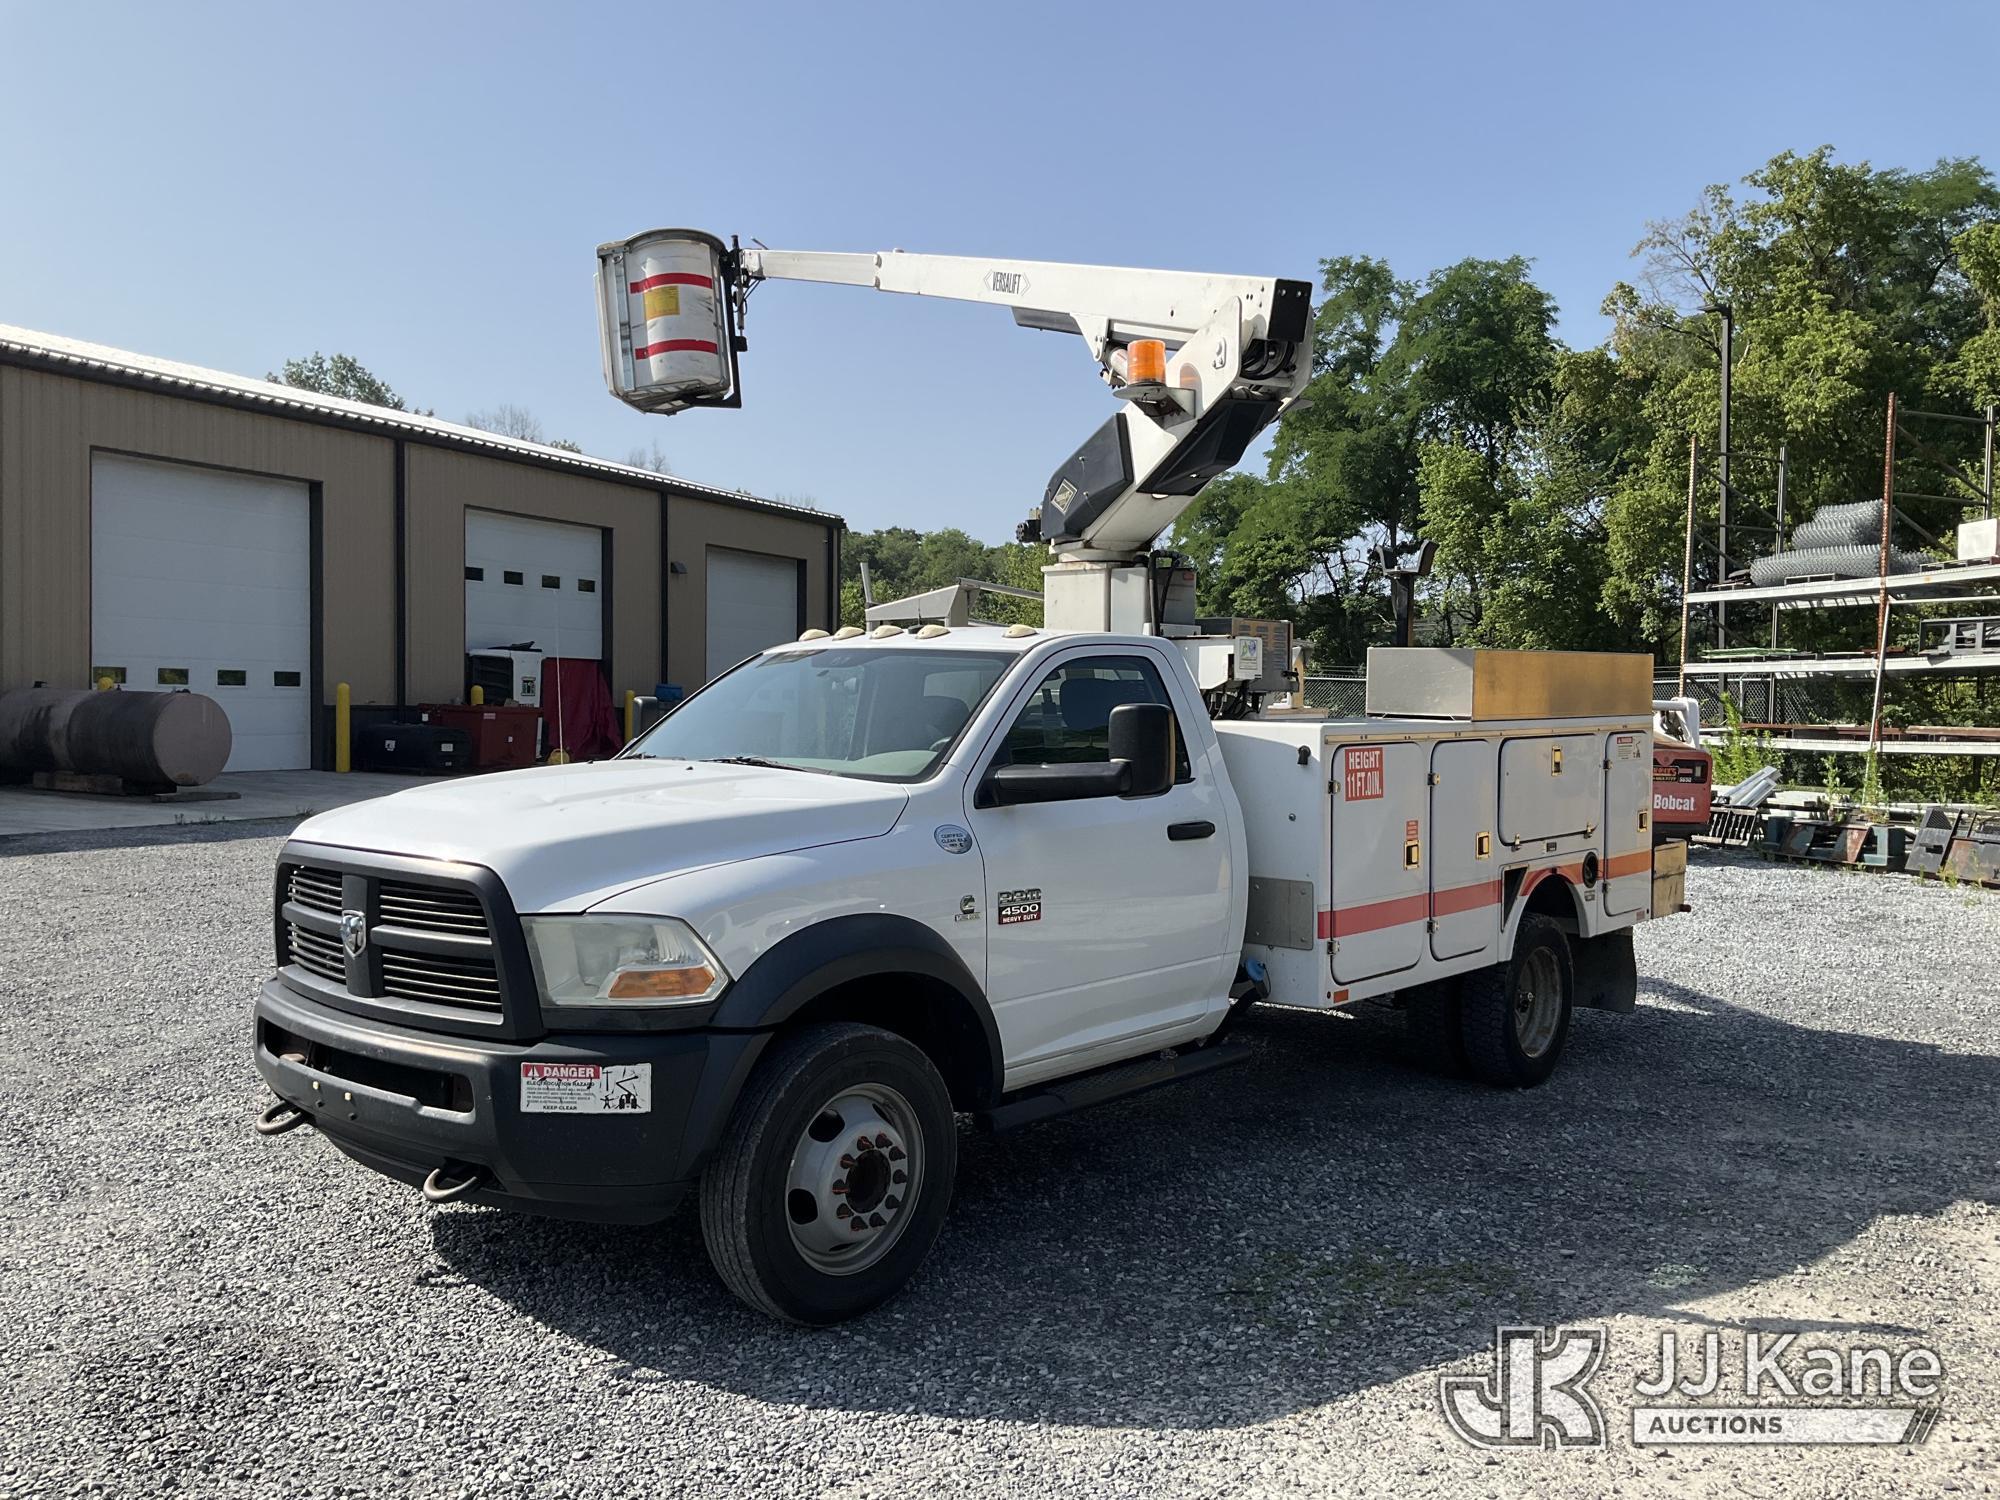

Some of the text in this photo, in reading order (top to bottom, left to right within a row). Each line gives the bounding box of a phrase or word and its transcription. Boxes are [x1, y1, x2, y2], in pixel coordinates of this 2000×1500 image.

[992, 271, 1021, 295] VERSALIFT
[1349, 751, 1380, 769] HEIGHT
[1653, 794, 1695, 811] Bobcat
[1002, 904, 1039, 915] 4500
[1002, 913, 1038, 924] HEAVY DUTY
[543, 1066, 595, 1078] DANGER
